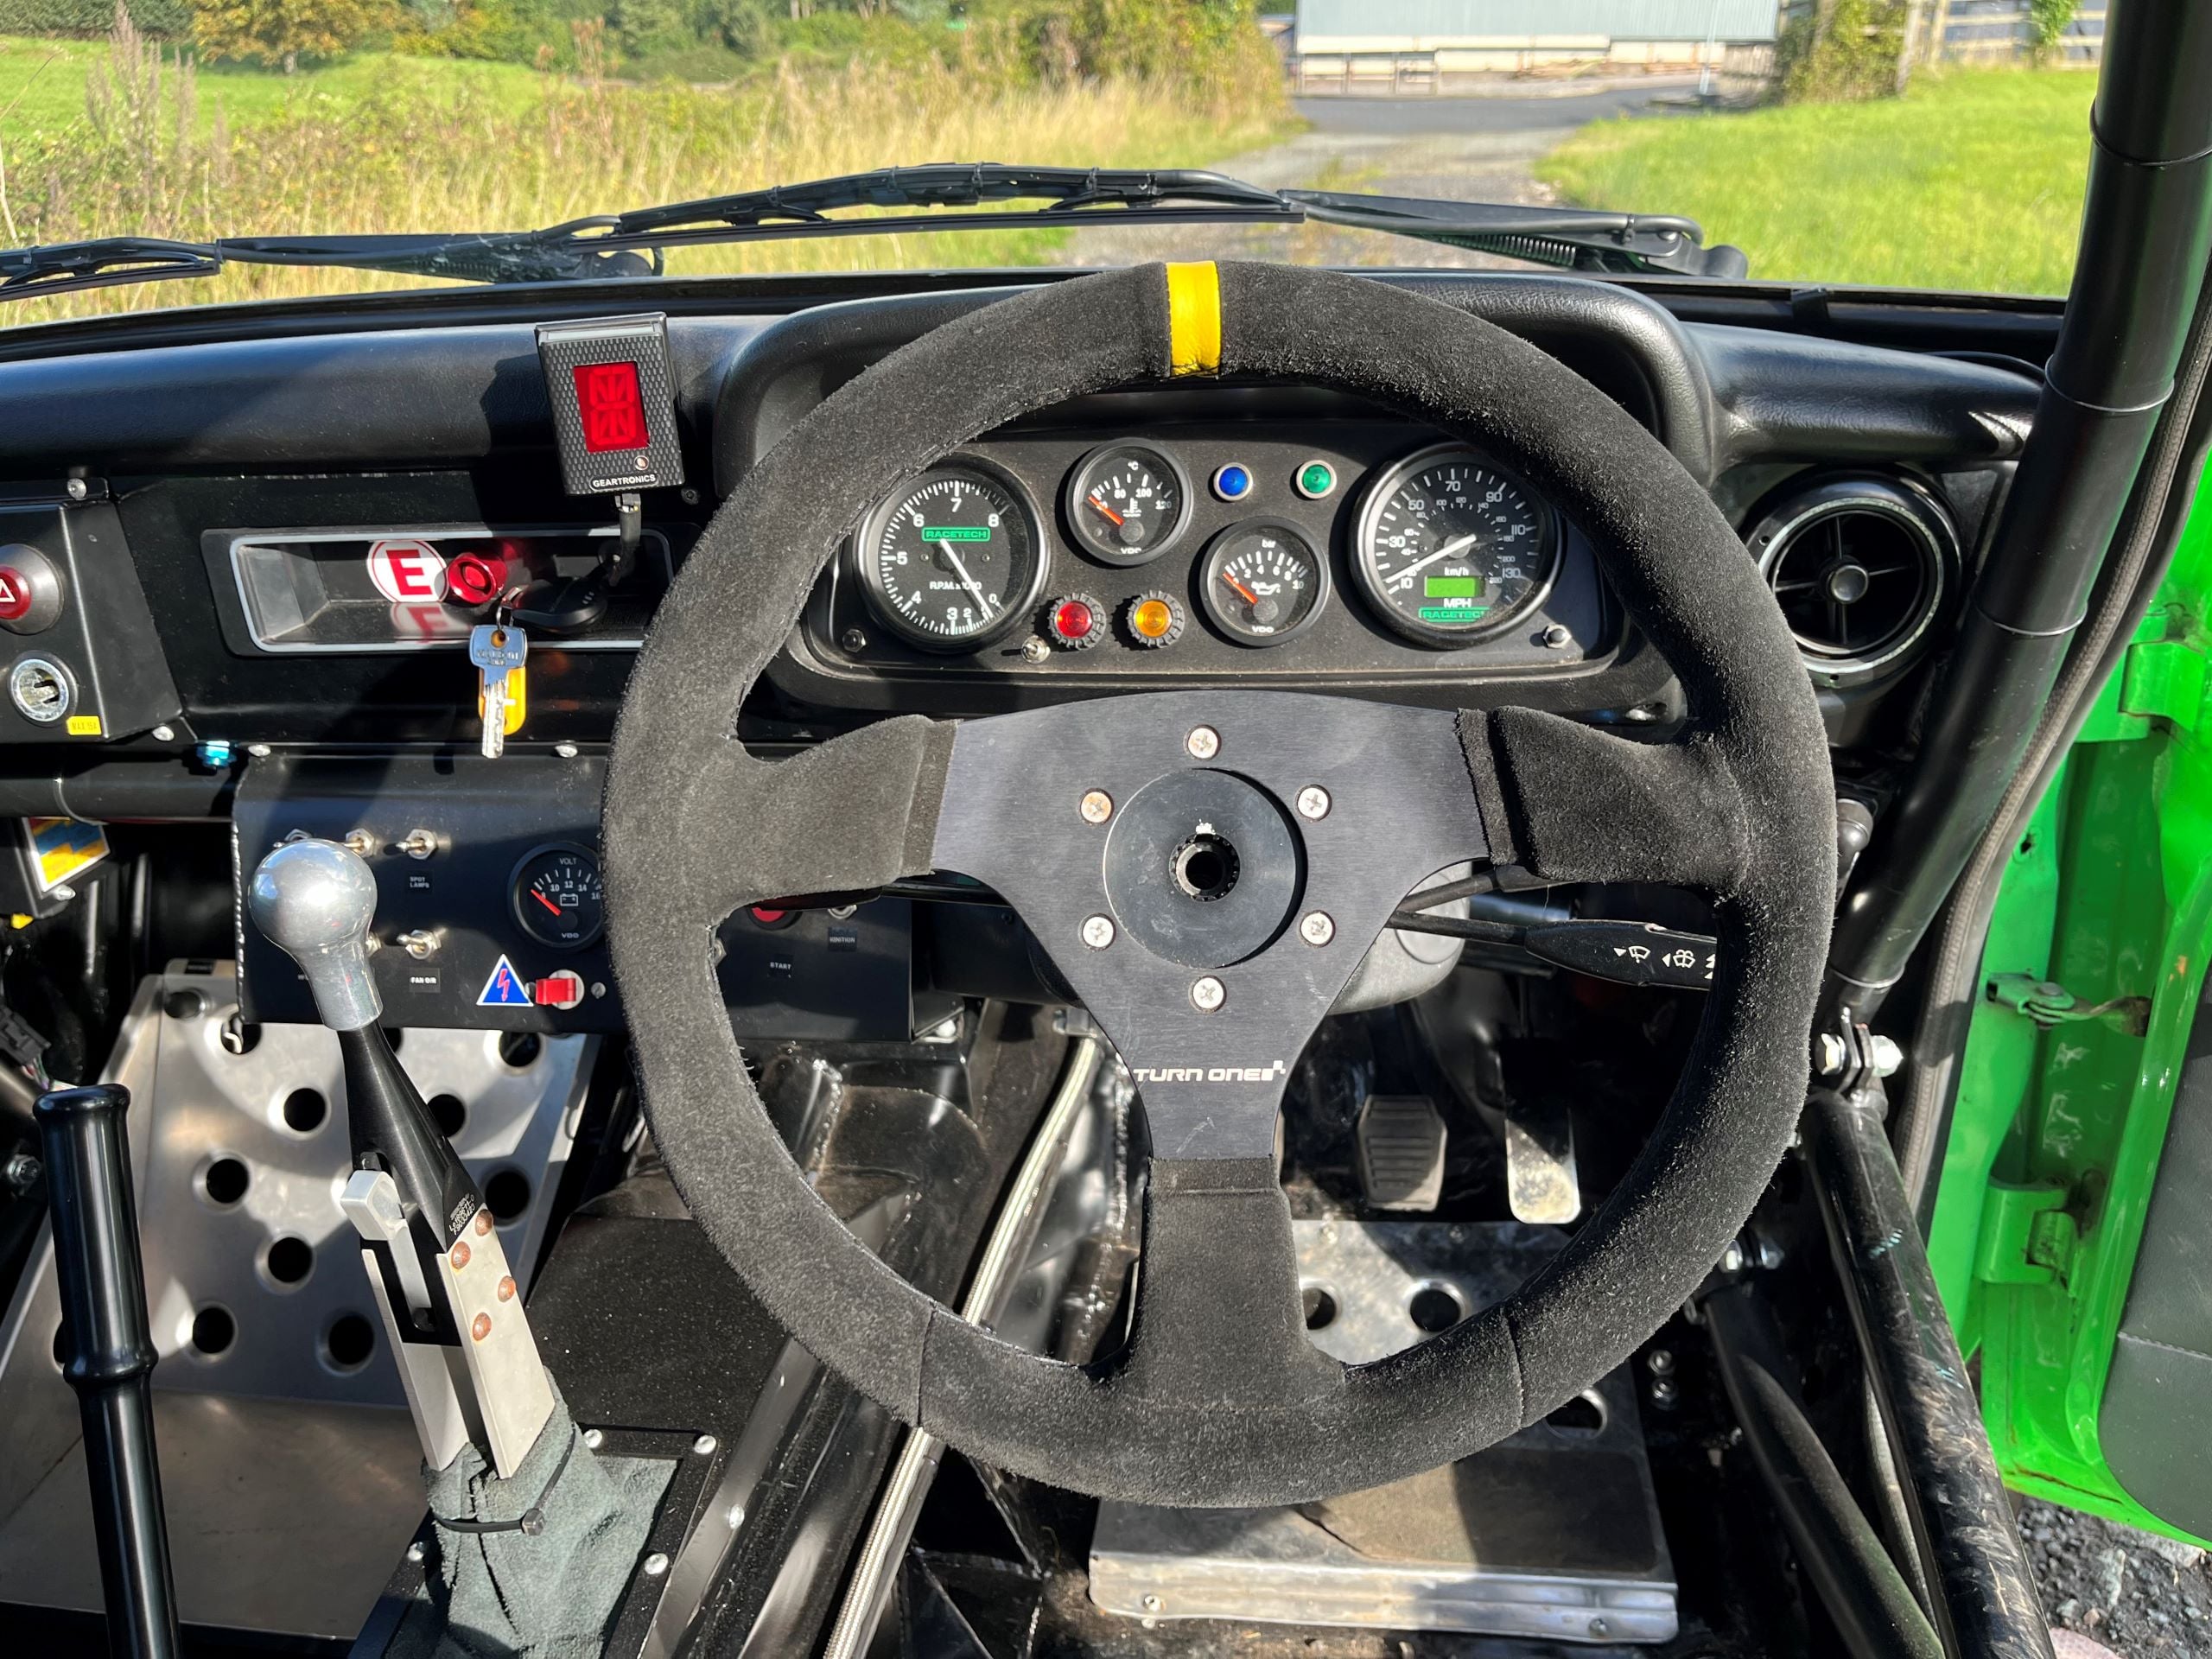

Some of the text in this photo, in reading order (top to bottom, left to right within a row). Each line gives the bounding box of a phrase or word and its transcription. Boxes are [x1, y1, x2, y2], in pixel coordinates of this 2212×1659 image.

[592, 474, 656, 487] GEARTRONICS
[1445, 480, 1461, 492] 70
[1135, 487, 1153, 498] 100
[1486, 492, 1503, 502] 90
[950, 498, 962, 512] 7
[1155, 500, 1172, 510] 120
[1408, 499, 1425, 511] 50
[912, 513, 925, 527] 6
[988, 513, 1000, 527] 8
[1511, 524, 1526, 536] 110
[1262, 539, 1276, 548] bar
[1389, 536, 1406, 548] 30
[896, 551, 908, 565] 5
[386, 550, 433, 595] E
[1243, 569, 1251, 579] 2
[1256, 564, 1264, 575] 4
[1273, 566, 1281, 575] 6
[1444, 567, 1469, 576] km/h
[1502, 568, 1521, 579] 130
[1284, 570, 1292, 581] 8
[1292, 579, 1305, 589] 10
[1400, 577, 1414, 588] 10
[911, 591, 922, 604] 4
[988, 594, 997, 604] 0
[1443, 598, 1471, 608] MPH
[946, 607, 958, 620] 3
[963, 607, 972, 618] 2
[564, 880, 574, 889] 12
[770, 961, 791, 970] START
[1133, 1068, 1262, 1082] TURN ONE
